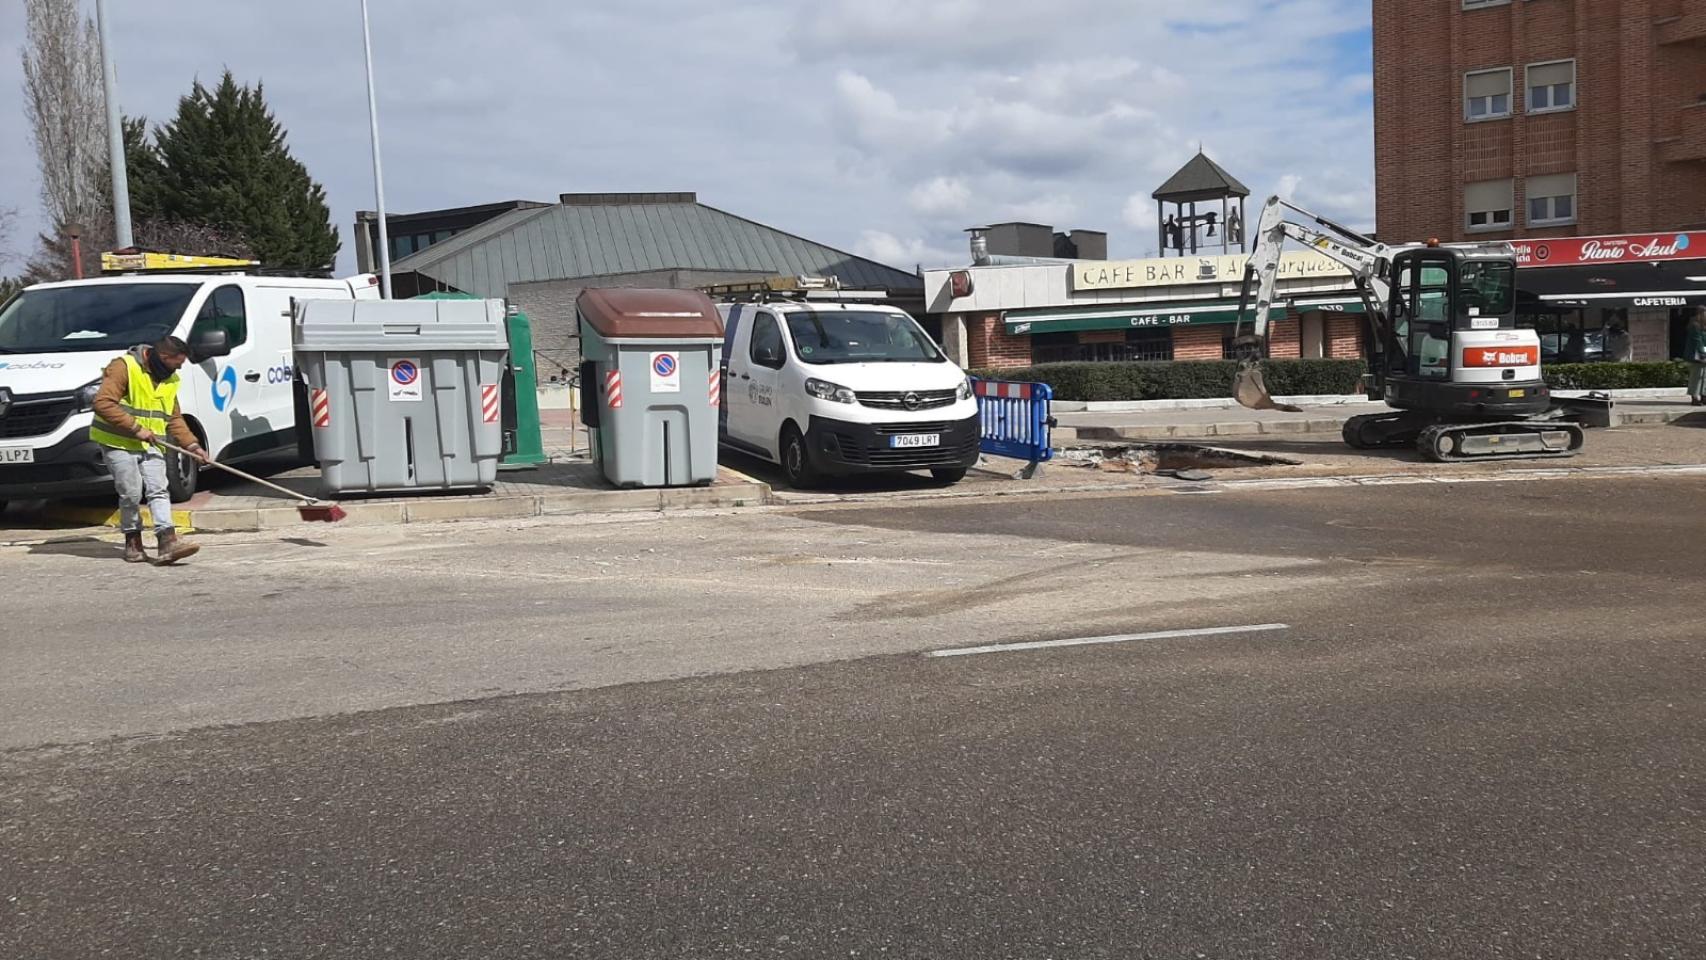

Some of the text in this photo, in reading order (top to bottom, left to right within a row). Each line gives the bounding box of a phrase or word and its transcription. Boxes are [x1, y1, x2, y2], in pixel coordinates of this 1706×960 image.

[1579, 238, 1679, 260] Punto Azul
[1146, 264, 1185, 281] BAR
[1317, 304, 1344, 312] ALTO
[1169, 314, 1190, 324] BAR
[1499, 351, 1528, 364] Bobcat
[6, 361, 65, 370] cobra
[897, 435, 938, 446] 7049 LRT
[6, 449, 30, 462] LPZ
